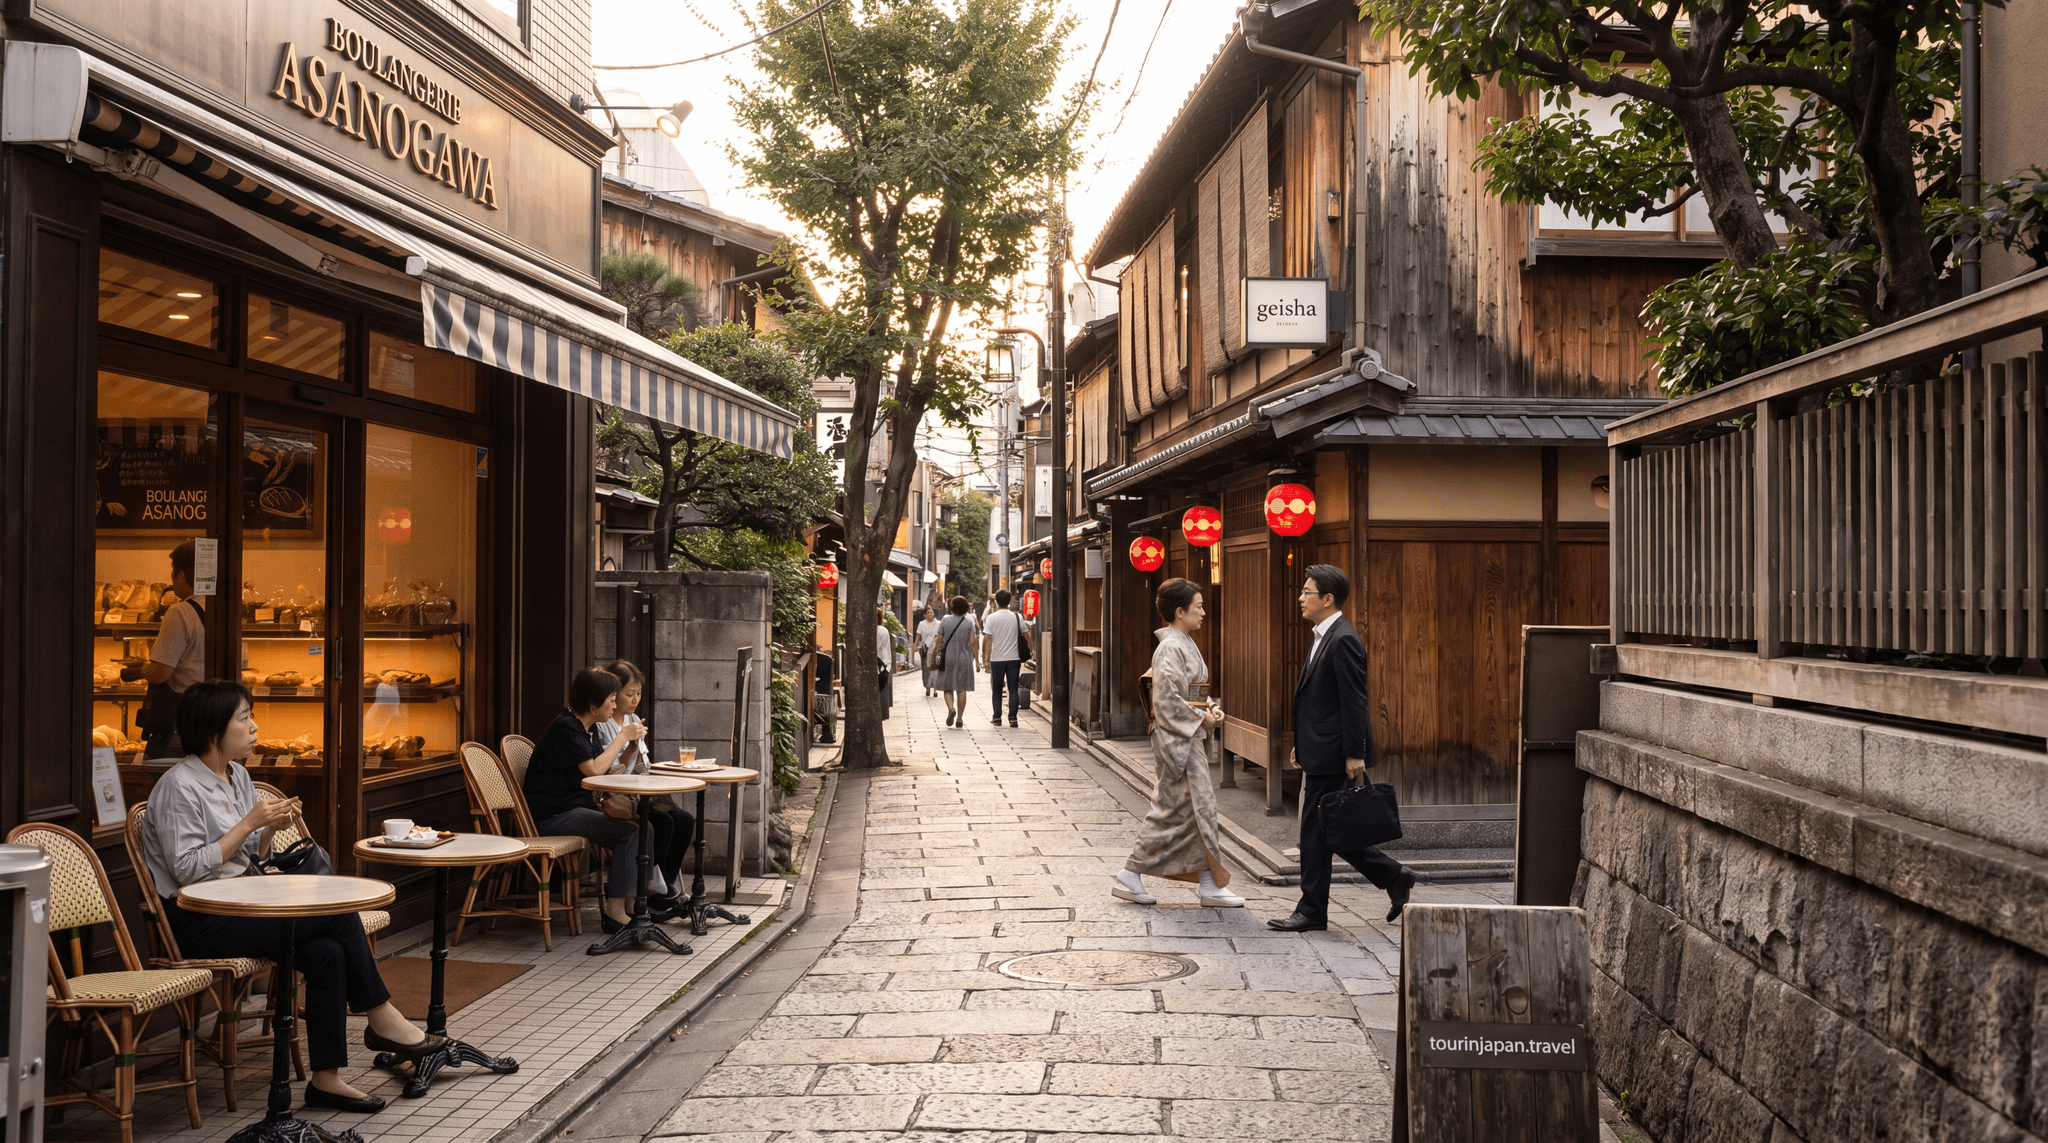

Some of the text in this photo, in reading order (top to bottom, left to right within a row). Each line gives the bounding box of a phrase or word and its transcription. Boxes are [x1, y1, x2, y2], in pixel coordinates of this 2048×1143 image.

[326, 18, 461, 125] BOULANGERIE
[272, 42, 499, 210] ASANOGAWA
[1257, 298, 1317, 322] geisha
[142, 504, 207, 520] ASANOG
[1429, 1036, 1575, 1056] tourinjapan.travel
